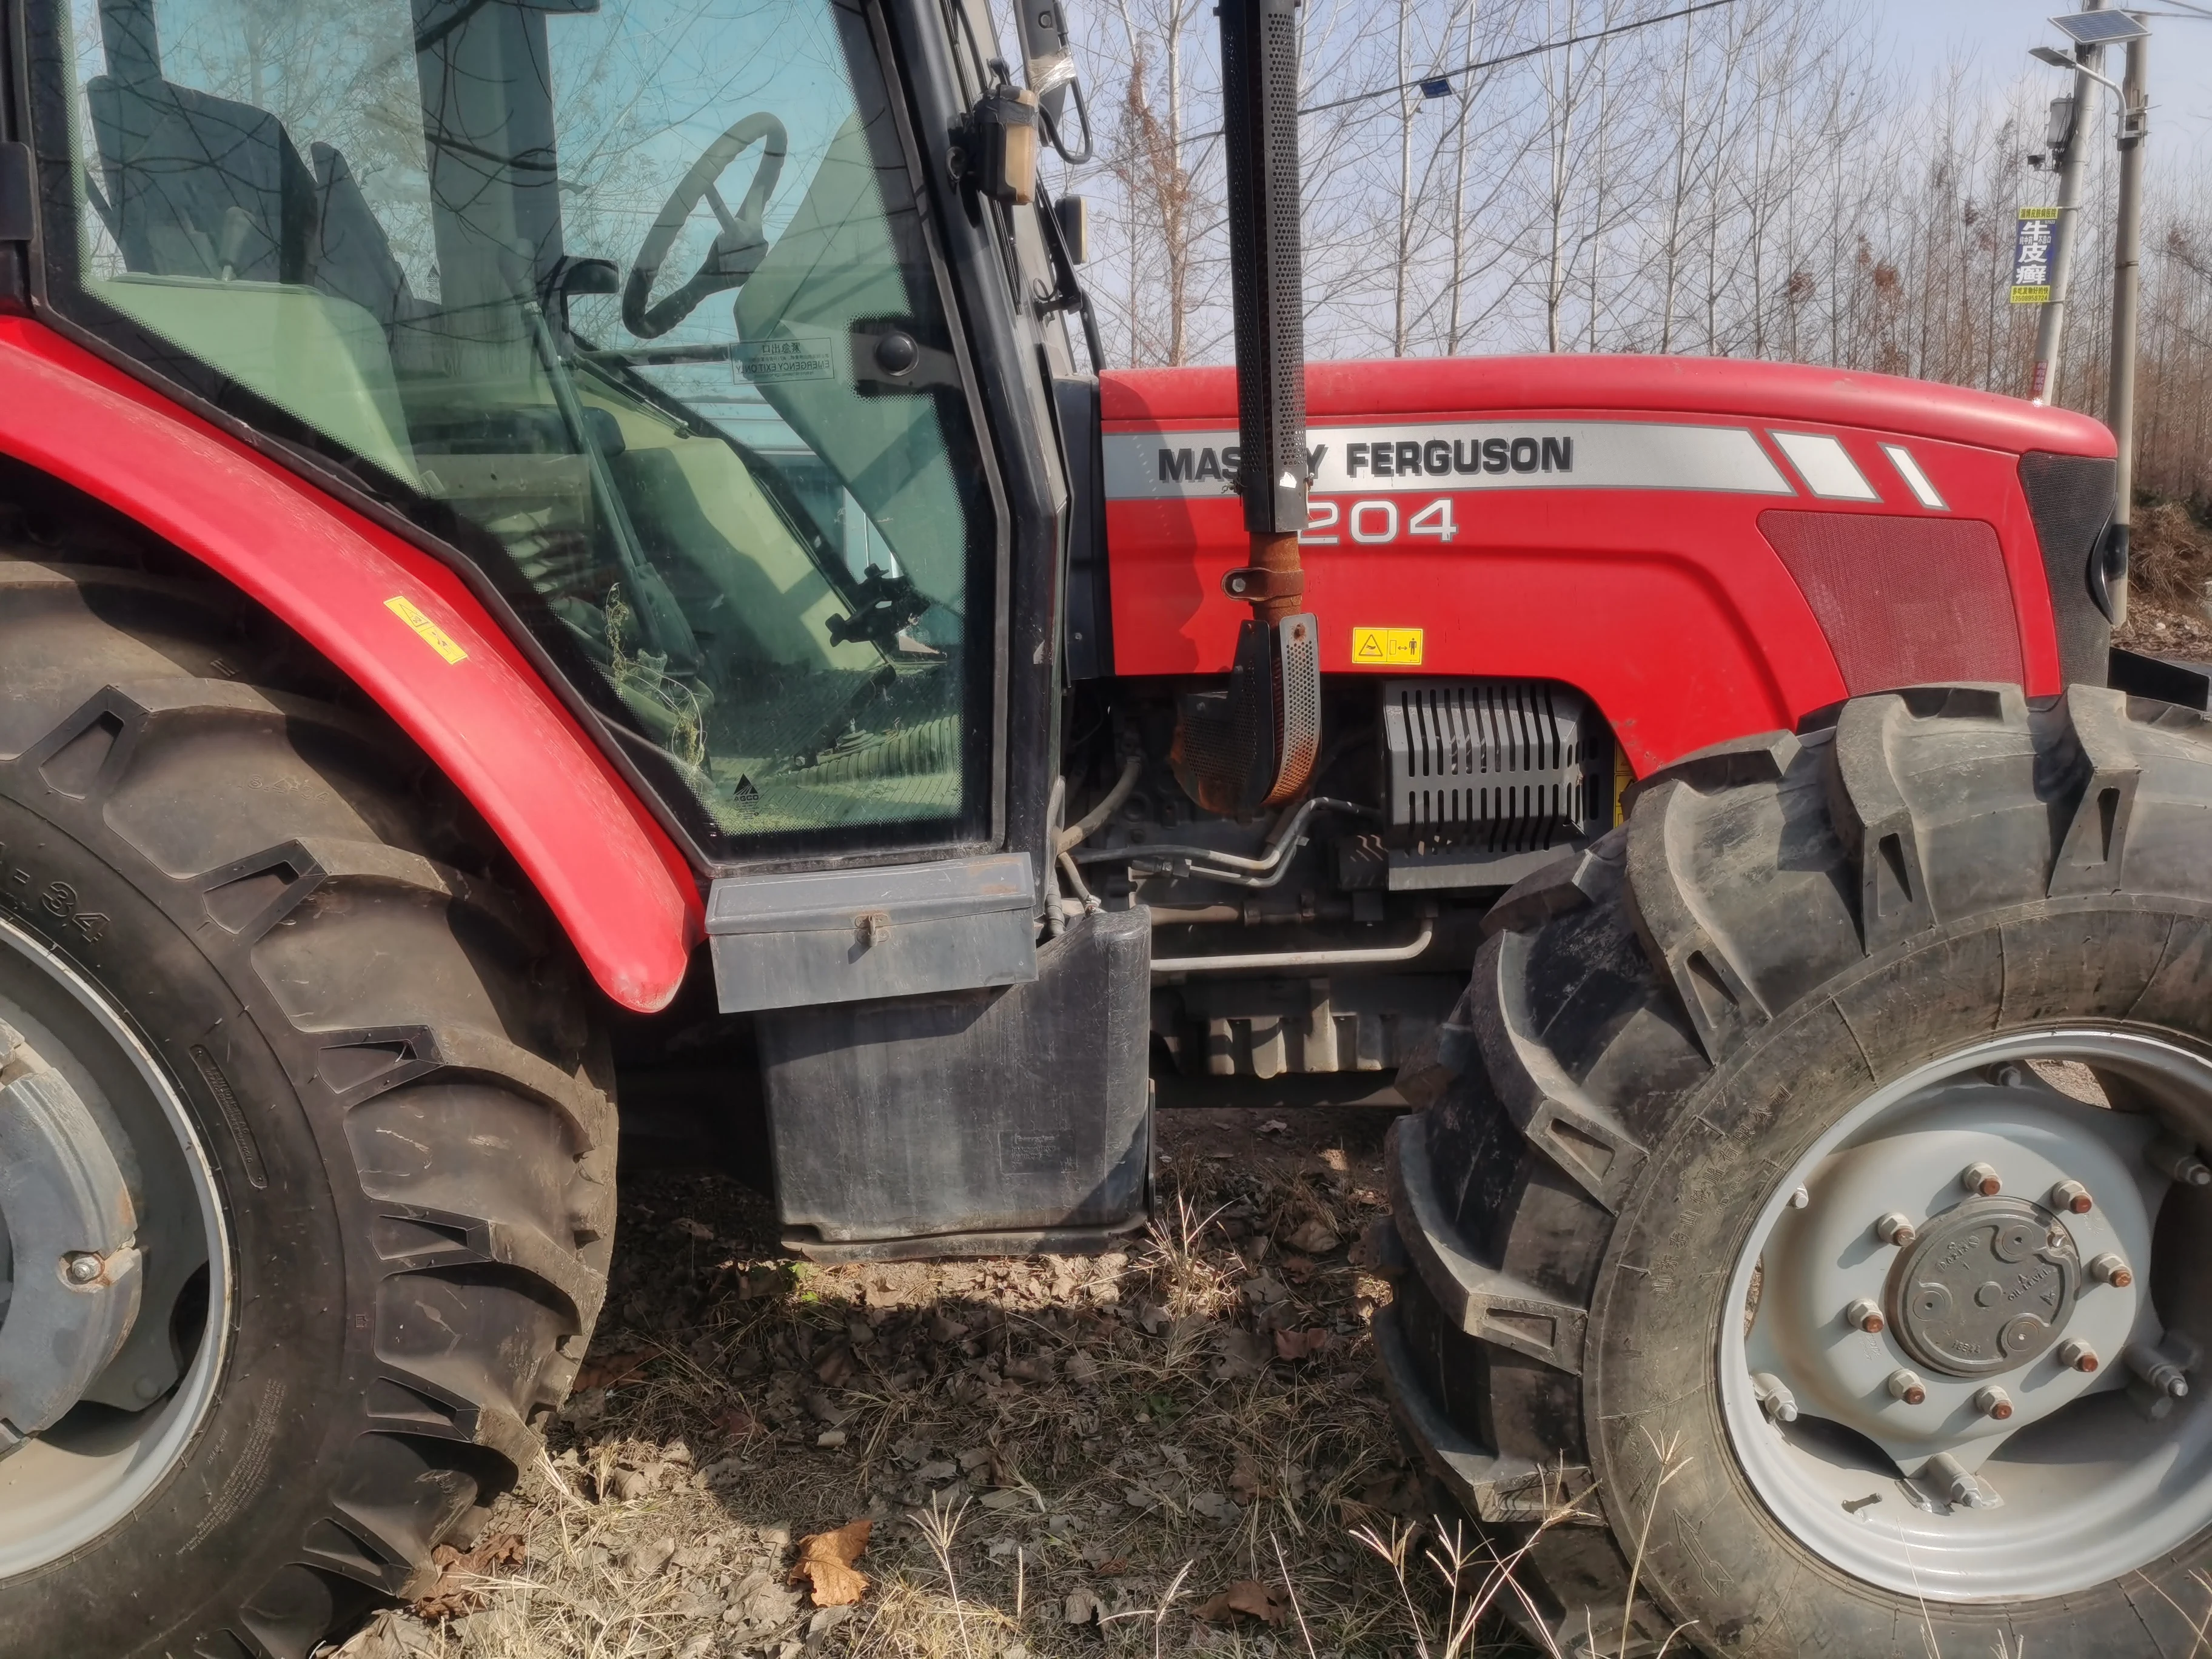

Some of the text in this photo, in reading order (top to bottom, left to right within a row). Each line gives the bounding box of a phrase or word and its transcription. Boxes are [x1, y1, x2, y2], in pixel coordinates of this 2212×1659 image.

[2016, 220, 2050, 285] 牛皮癣
[1159, 436, 1573, 482] MASY FERGUSON
